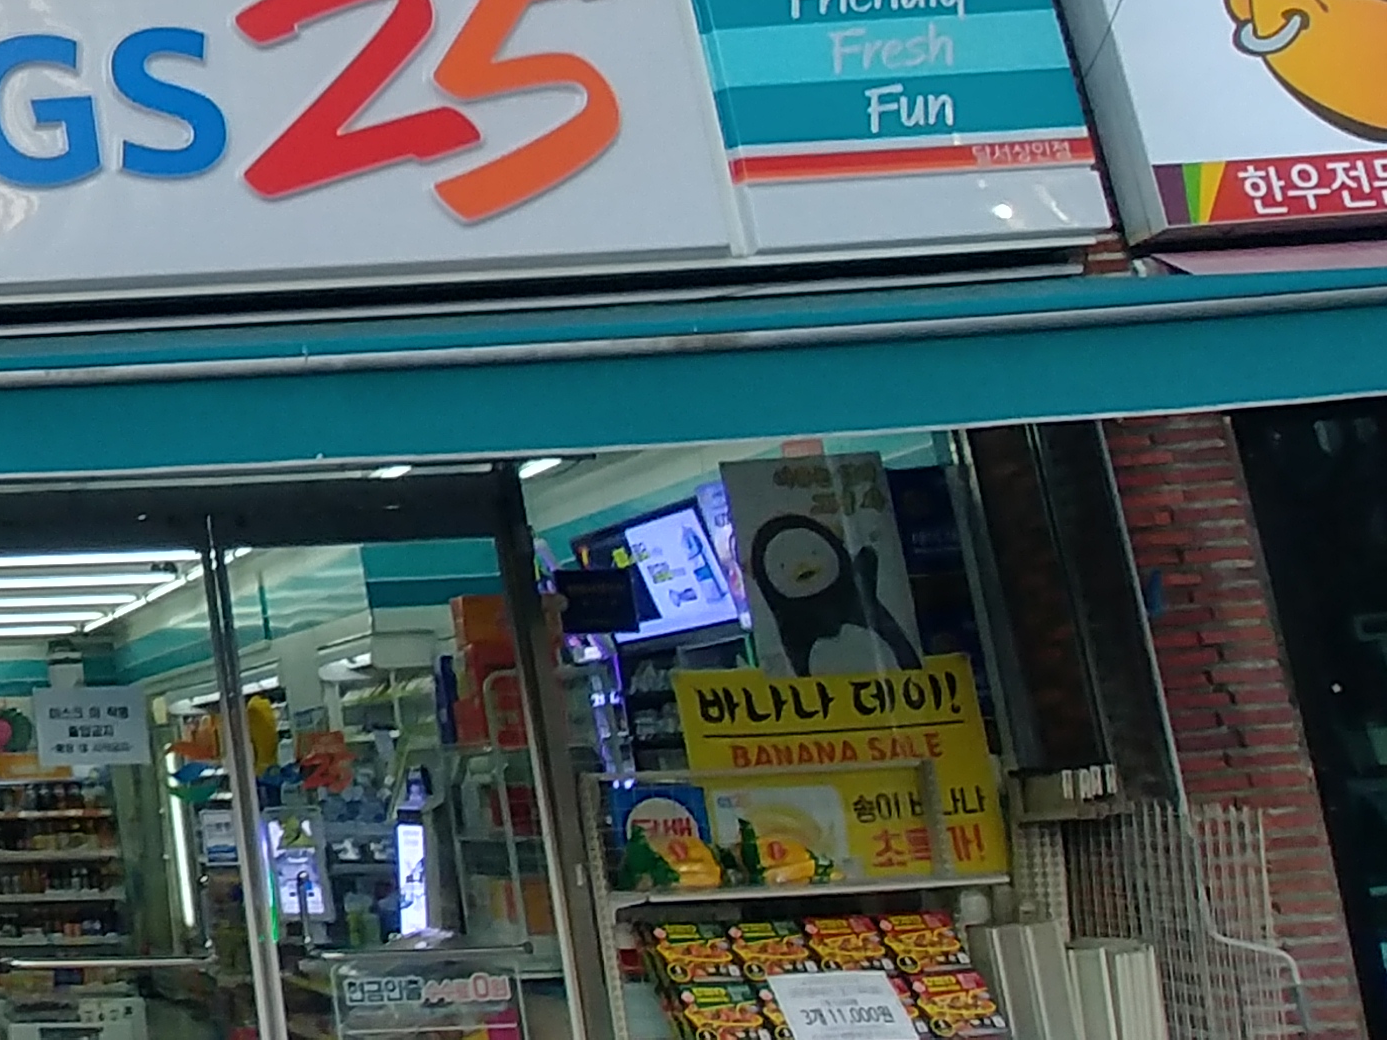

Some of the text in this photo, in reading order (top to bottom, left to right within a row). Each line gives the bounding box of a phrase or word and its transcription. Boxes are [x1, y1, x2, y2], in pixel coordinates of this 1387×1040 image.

[829, 22, 954, 75] Fresh
[864, 83, 954, 134] Fun
[694, 671, 963, 723] 바나나 데이!
[731, 731, 944, 768] BANANA SALE
[852, 791, 902, 824] 송이
